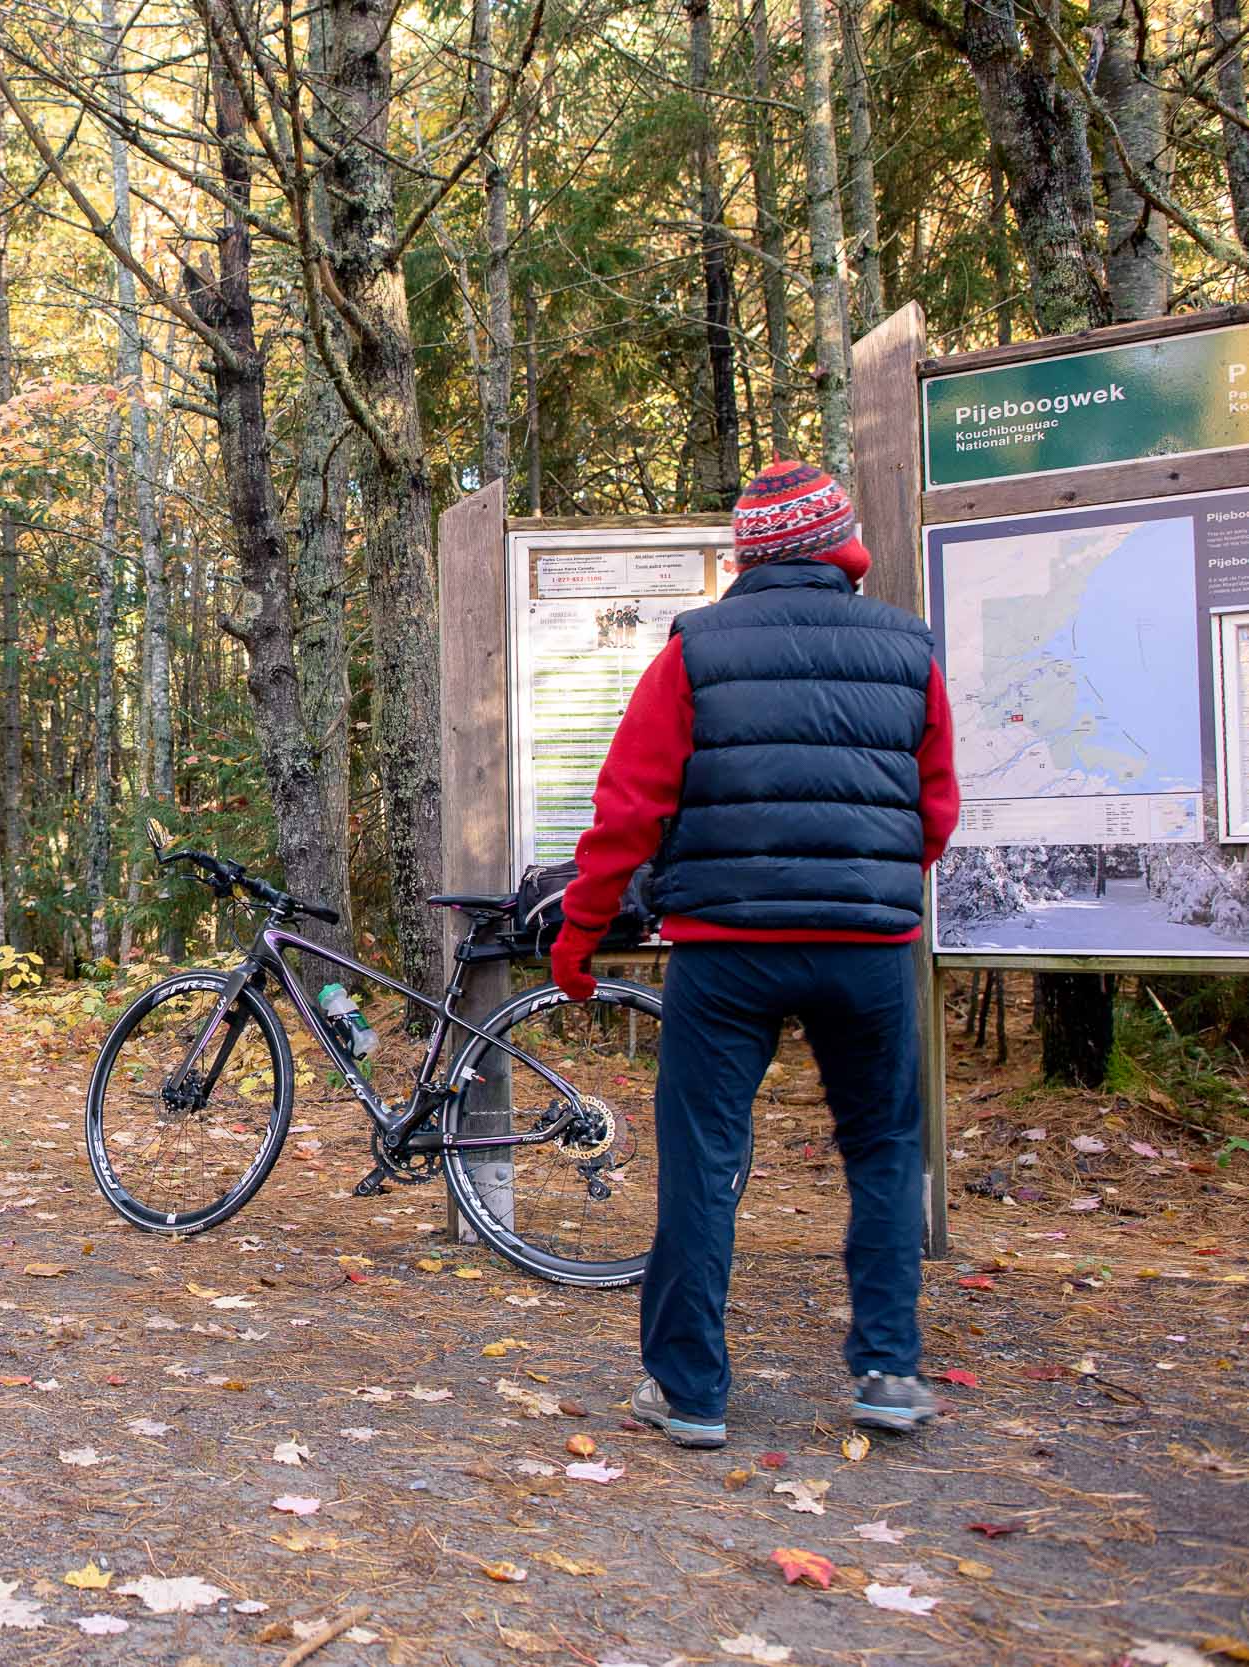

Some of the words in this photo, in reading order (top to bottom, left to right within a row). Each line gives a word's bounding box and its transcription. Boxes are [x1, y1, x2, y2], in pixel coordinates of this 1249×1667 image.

[955, 383, 1127, 426] Pijeboogwek
[955, 418, 1059, 442] Kouchibouguac
[955, 435, 1011, 452] National
[1014, 431, 1046, 444] Park
[1206, 510, 1249, 523] Pijebo
[1208, 557, 1249, 569] Pijebo
